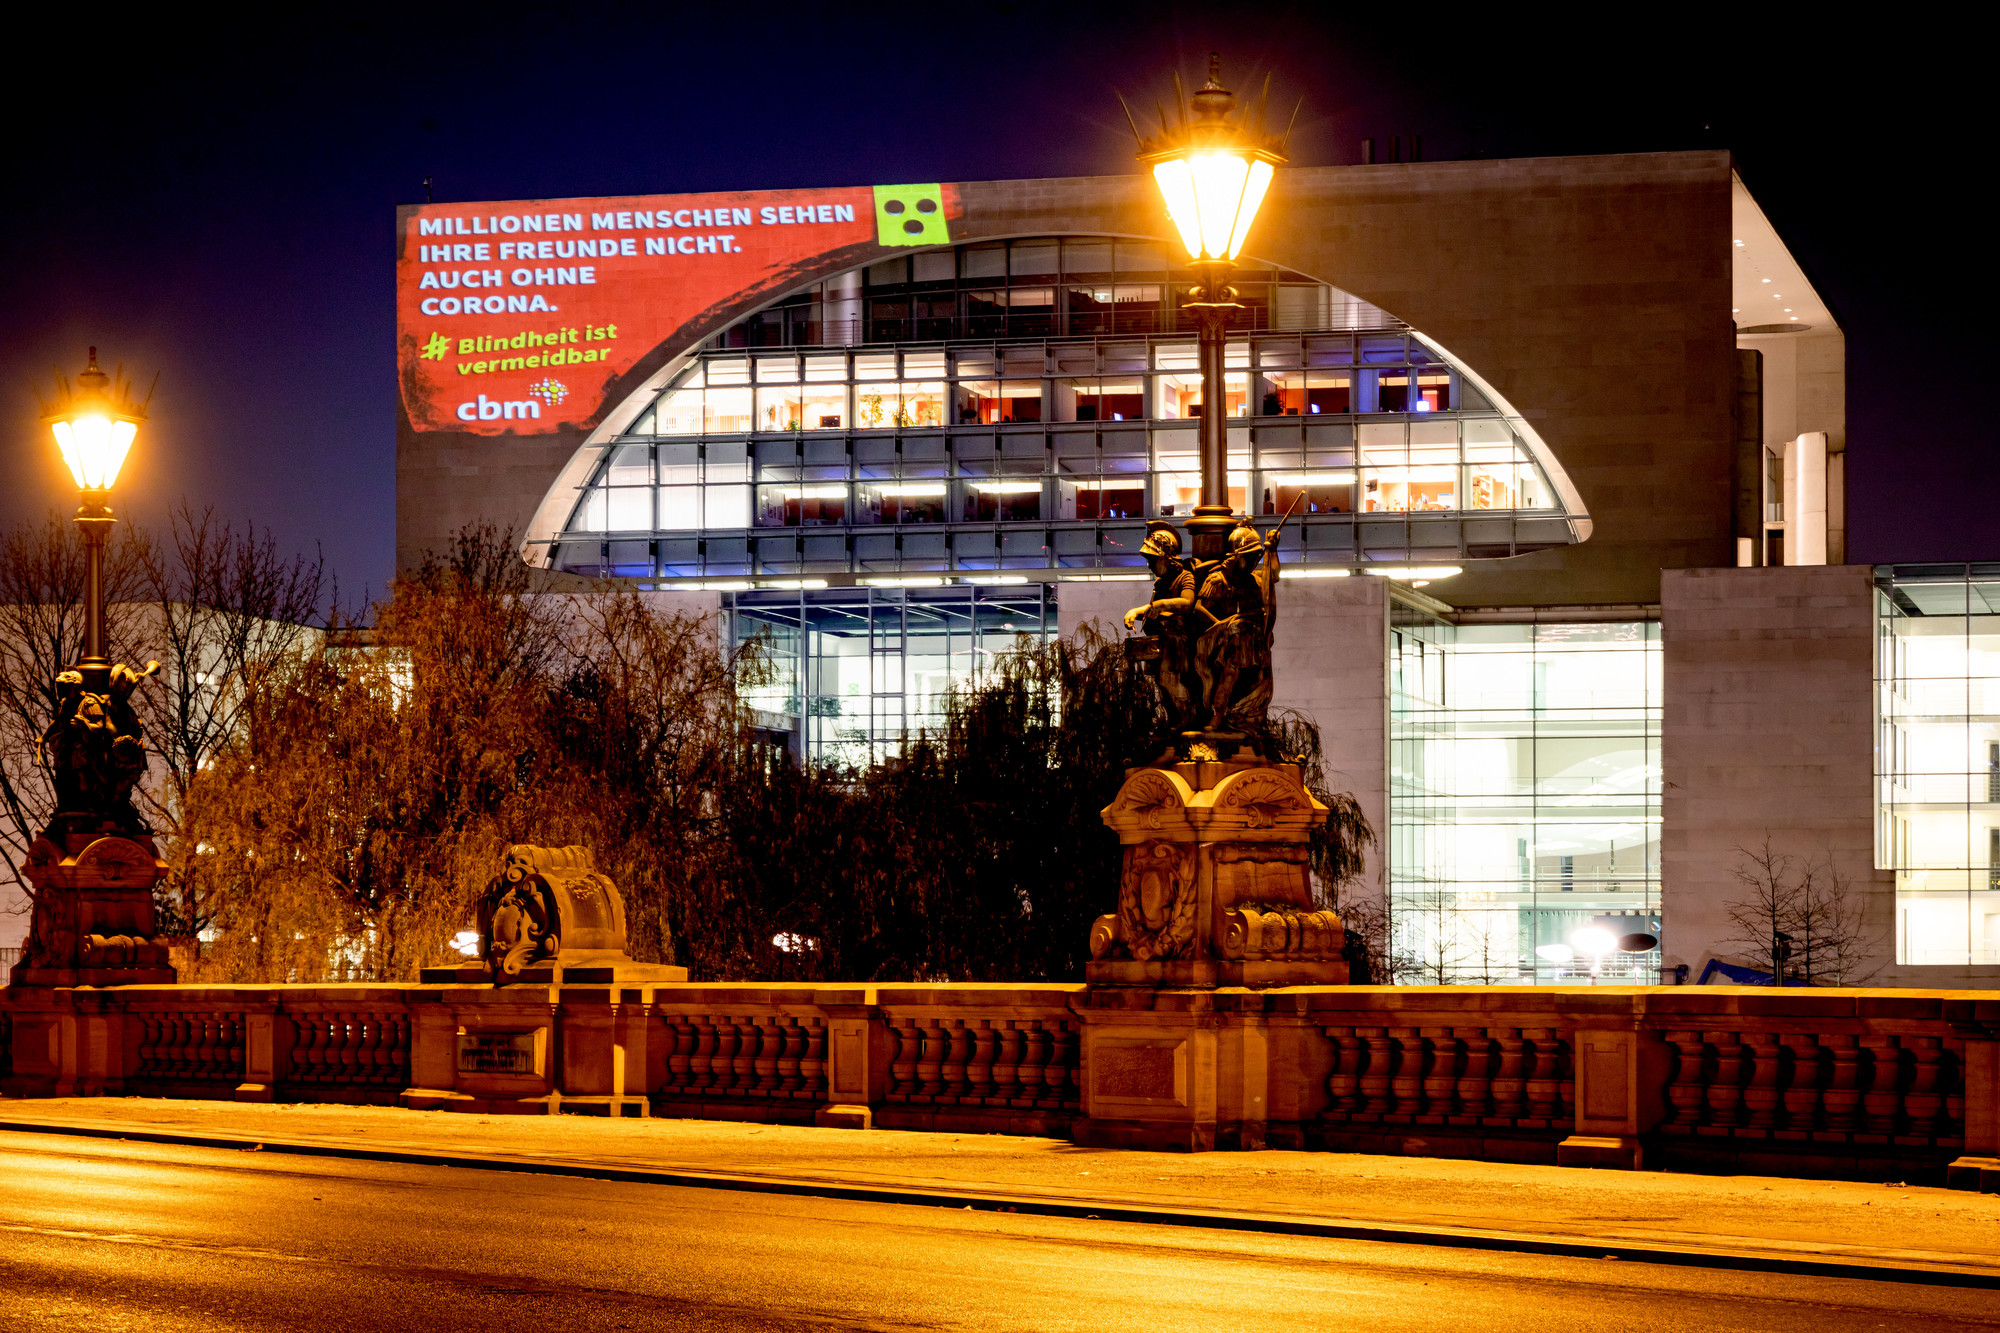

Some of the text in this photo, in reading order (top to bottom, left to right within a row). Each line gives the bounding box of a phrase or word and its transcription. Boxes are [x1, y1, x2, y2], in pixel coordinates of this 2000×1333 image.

[420, 204, 855, 236] MILLIONEN MENSCHEN SEHEN
[420, 235, 742, 262] IHRE FREUNDE NICHT.
[420, 266, 597, 289] AUCH OHNE
[421, 294, 558, 316] CORONA.
[585, 323, 618, 342] ist
[458, 347, 612, 375] vermeidbar
[457, 394, 541, 421] cbm
